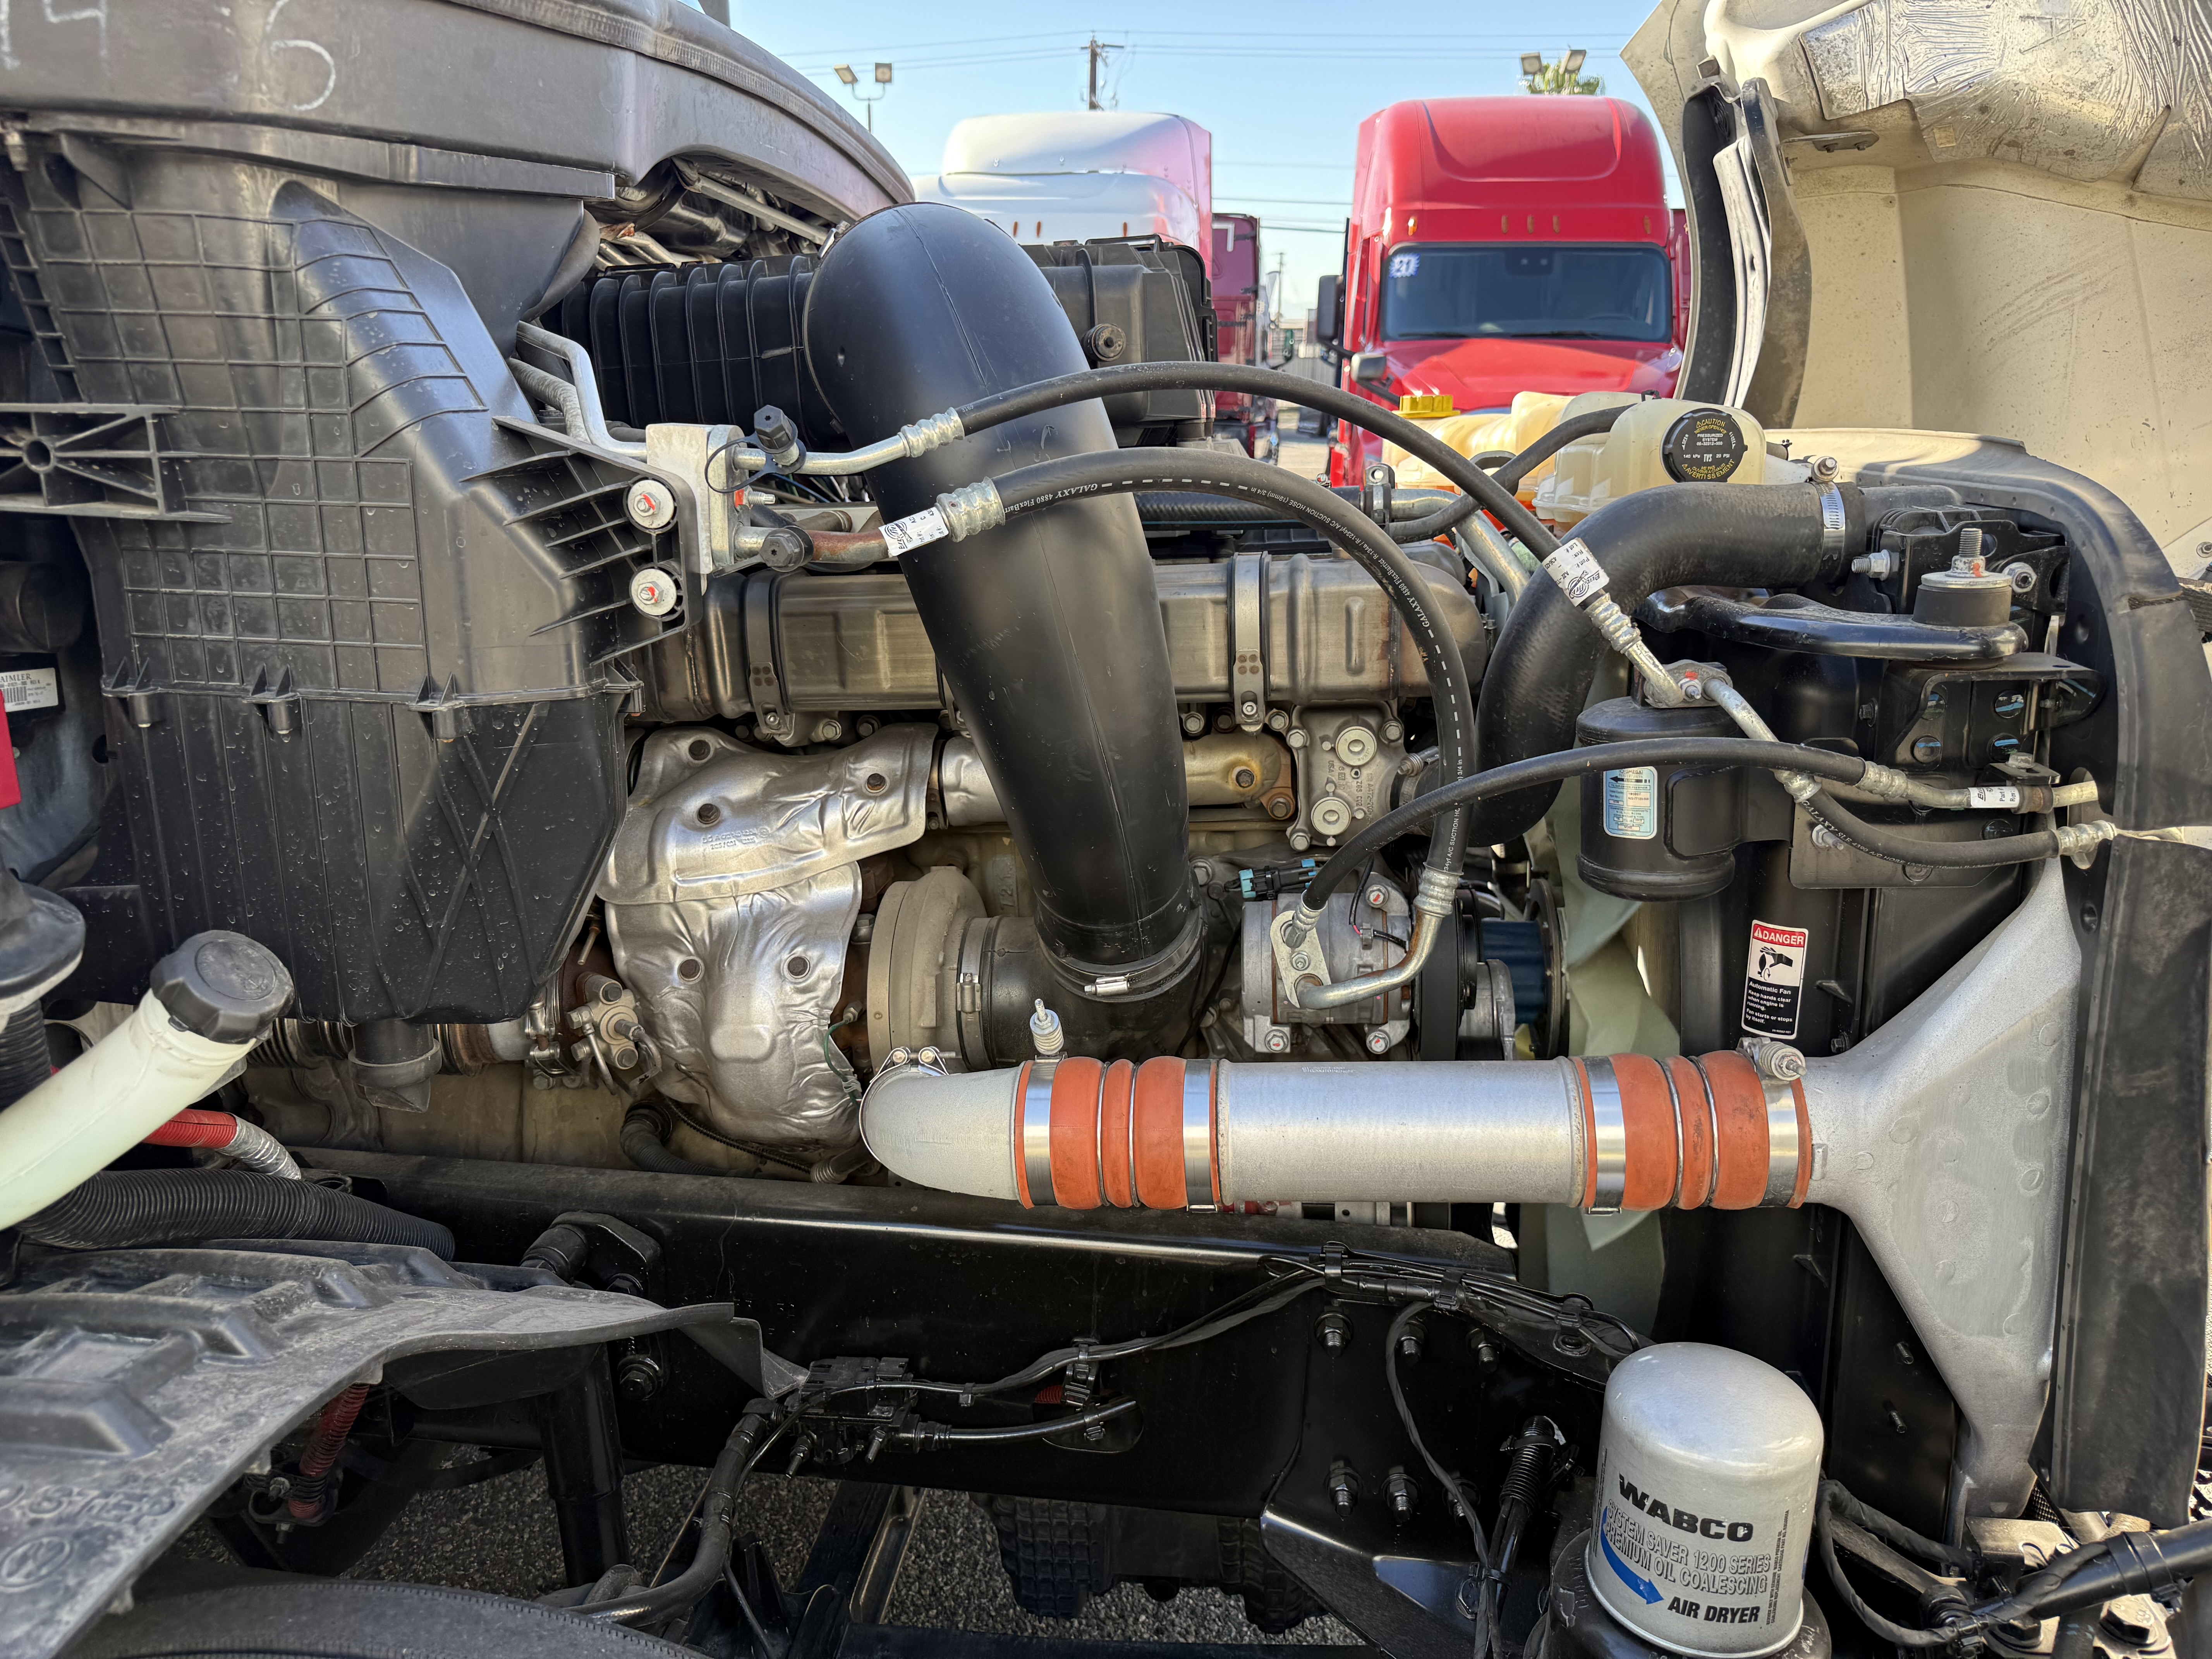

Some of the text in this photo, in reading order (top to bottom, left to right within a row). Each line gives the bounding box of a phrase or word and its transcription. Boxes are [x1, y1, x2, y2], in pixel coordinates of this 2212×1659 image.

[1702, 419, 1726, 427] CAUTION
[1704, 454, 1712, 462] TVS
[1005, 483, 1097, 513] GALAXY 4880 FlexBarr
[1267, 491, 1289, 503] (19mm)
[1288, 500, 1306, 511] HOSE
[1305, 507, 1331, 524] SUCTION
[1330, 520, 1341, 529] A/C
[1363, 543, 1379, 560] R-134a
[1378, 558, 1402, 585] FlexBarrier
[1398, 583, 1410, 596] 4880
[1407, 597, 1430, 627] GALAXY
[1, 673, 32, 682] AIMLER
[1450, 818, 1459, 846] SUCTION
[1837, 832, 1852, 842] SLE
[1762, 930, 1804, 945] DANGER
[1748, 989, 1760, 998] Keep
[1749, 981, 1778, 993] Automatic
[1747, 1001, 1766, 1011] running.
[1619, 1473, 1753, 1542] WABCO
[1608, 1498, 1771, 1574] SYSTEM SAVER 1200 SERIES
[1606, 1517, 1768, 1595] PREMIUM OIL COALESCING
[1667, 1596, 1761, 1623] AIR DRYER
